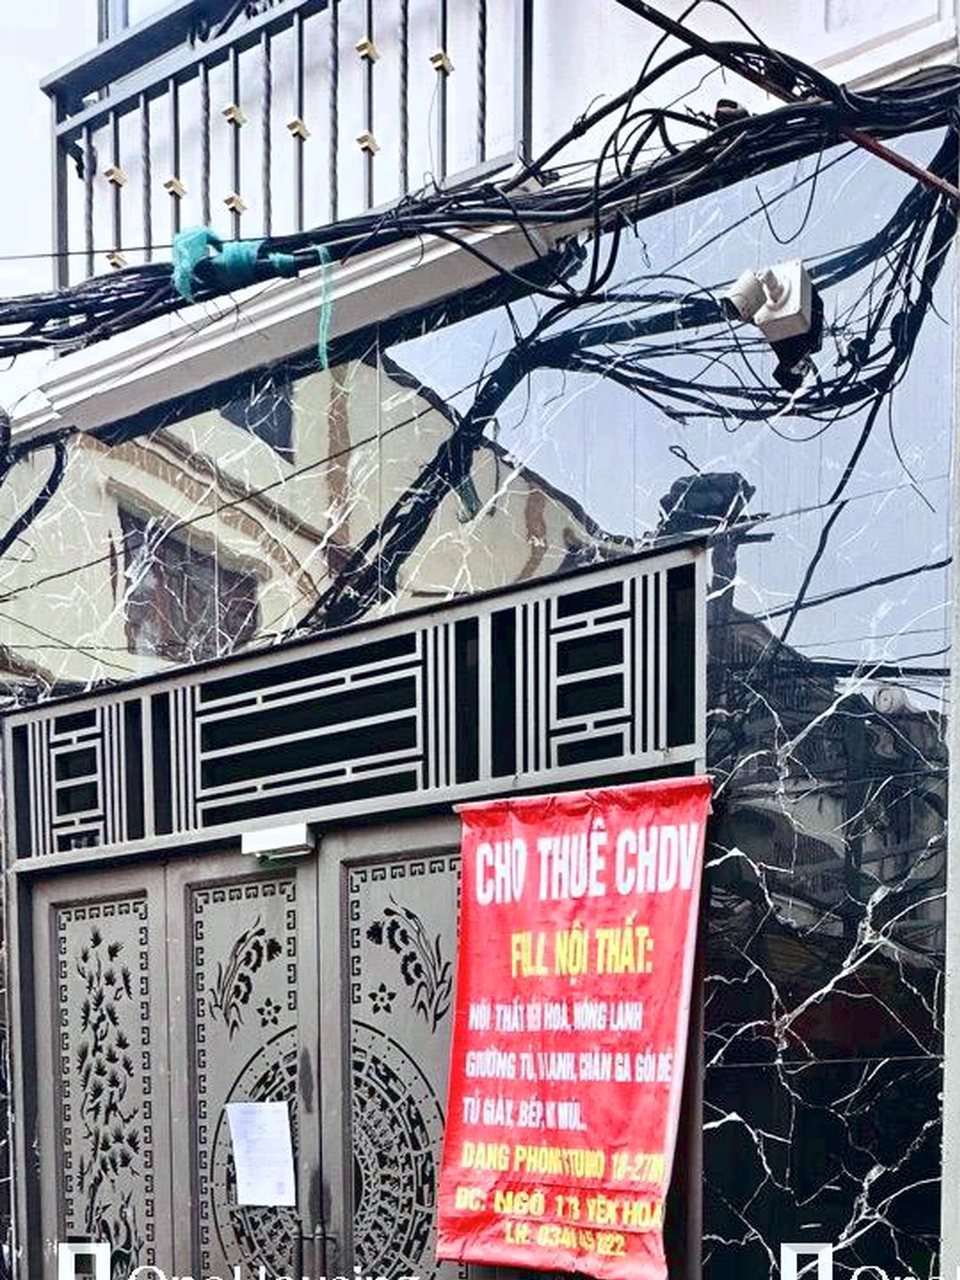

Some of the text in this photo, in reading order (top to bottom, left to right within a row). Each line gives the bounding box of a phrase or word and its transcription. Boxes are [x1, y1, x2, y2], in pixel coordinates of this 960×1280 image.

[476, 816, 699, 905] CHO THUÊ CHDV
[555, 918, 589, 985] NỘI
[595, 910, 655, 974] THẤT:
[462, 1088, 481, 1125] TỦ
[461, 1140, 511, 1175] DẠNG
